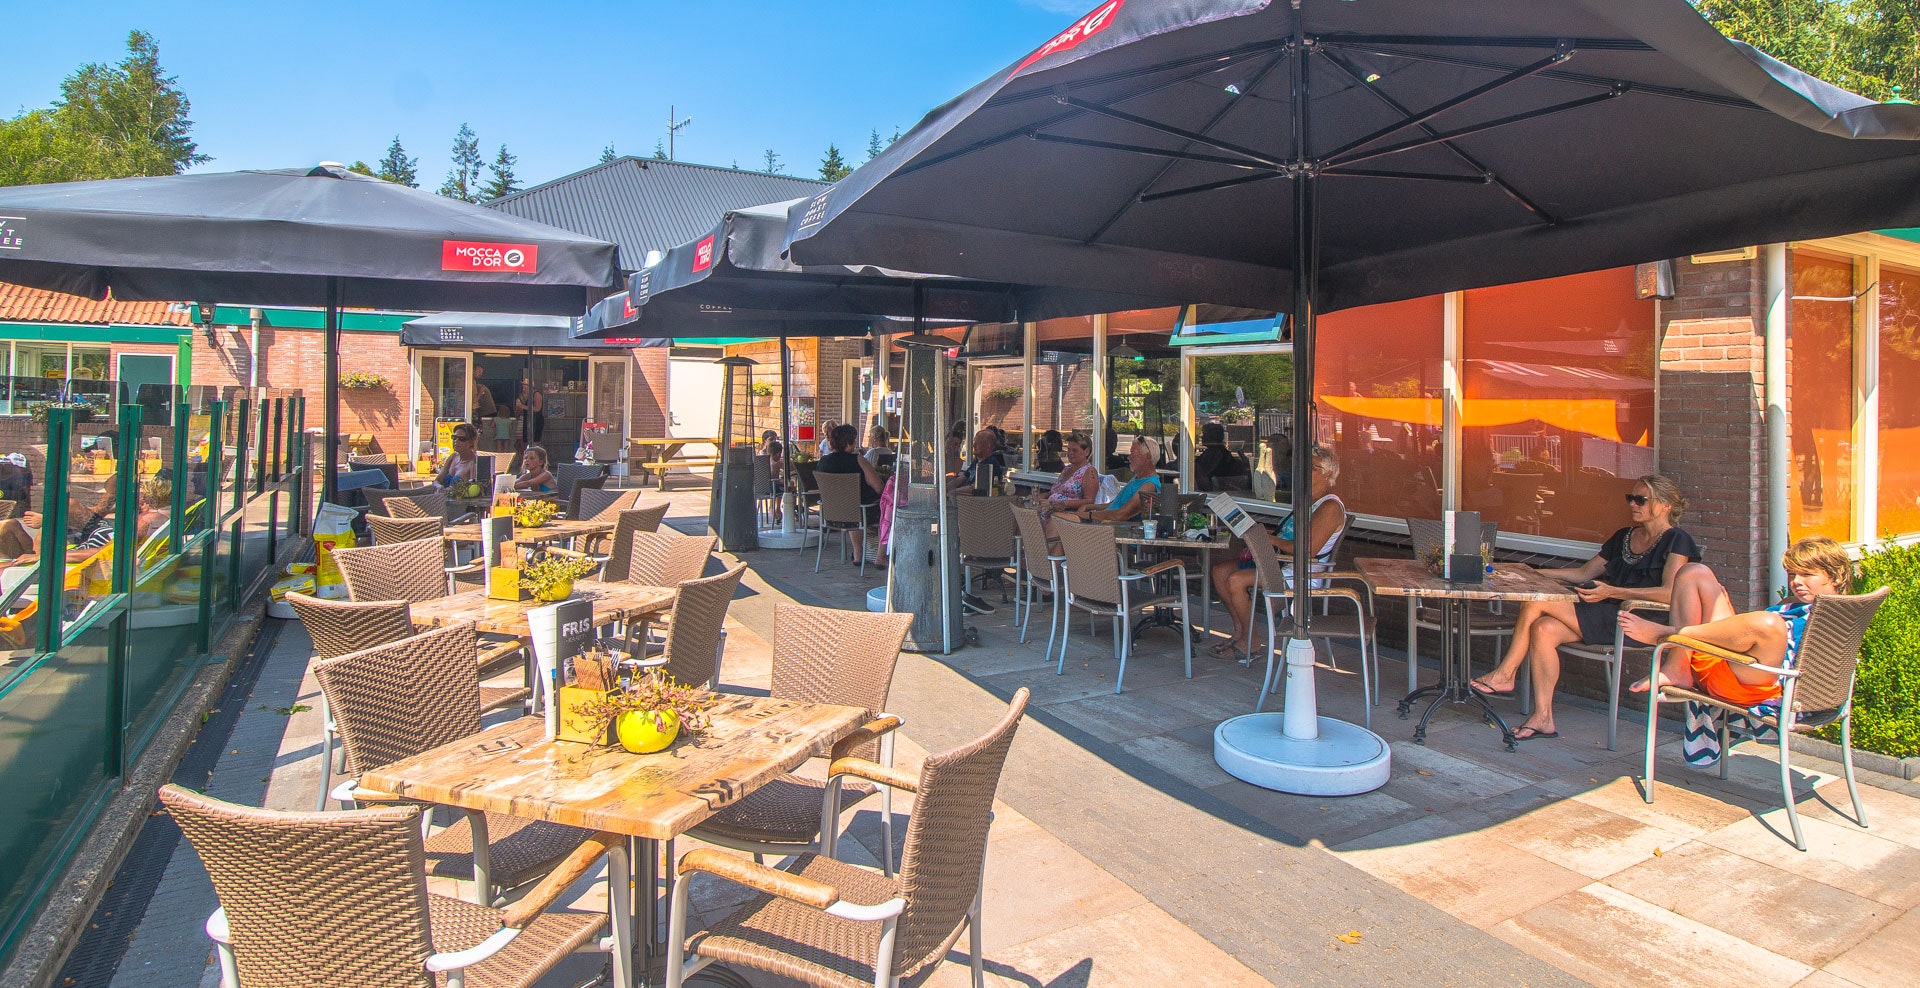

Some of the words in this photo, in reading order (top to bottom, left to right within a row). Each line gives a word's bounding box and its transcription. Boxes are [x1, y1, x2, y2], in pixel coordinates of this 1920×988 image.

[805, 202, 827, 218] ROAST
[810, 195, 828, 210] SLOW
[800, 210, 826, 226] COFFEE
[456, 247, 502, 258] MOCCA
[472, 257, 502, 267] D'OR
[562, 617, 590, 637] FRIS
